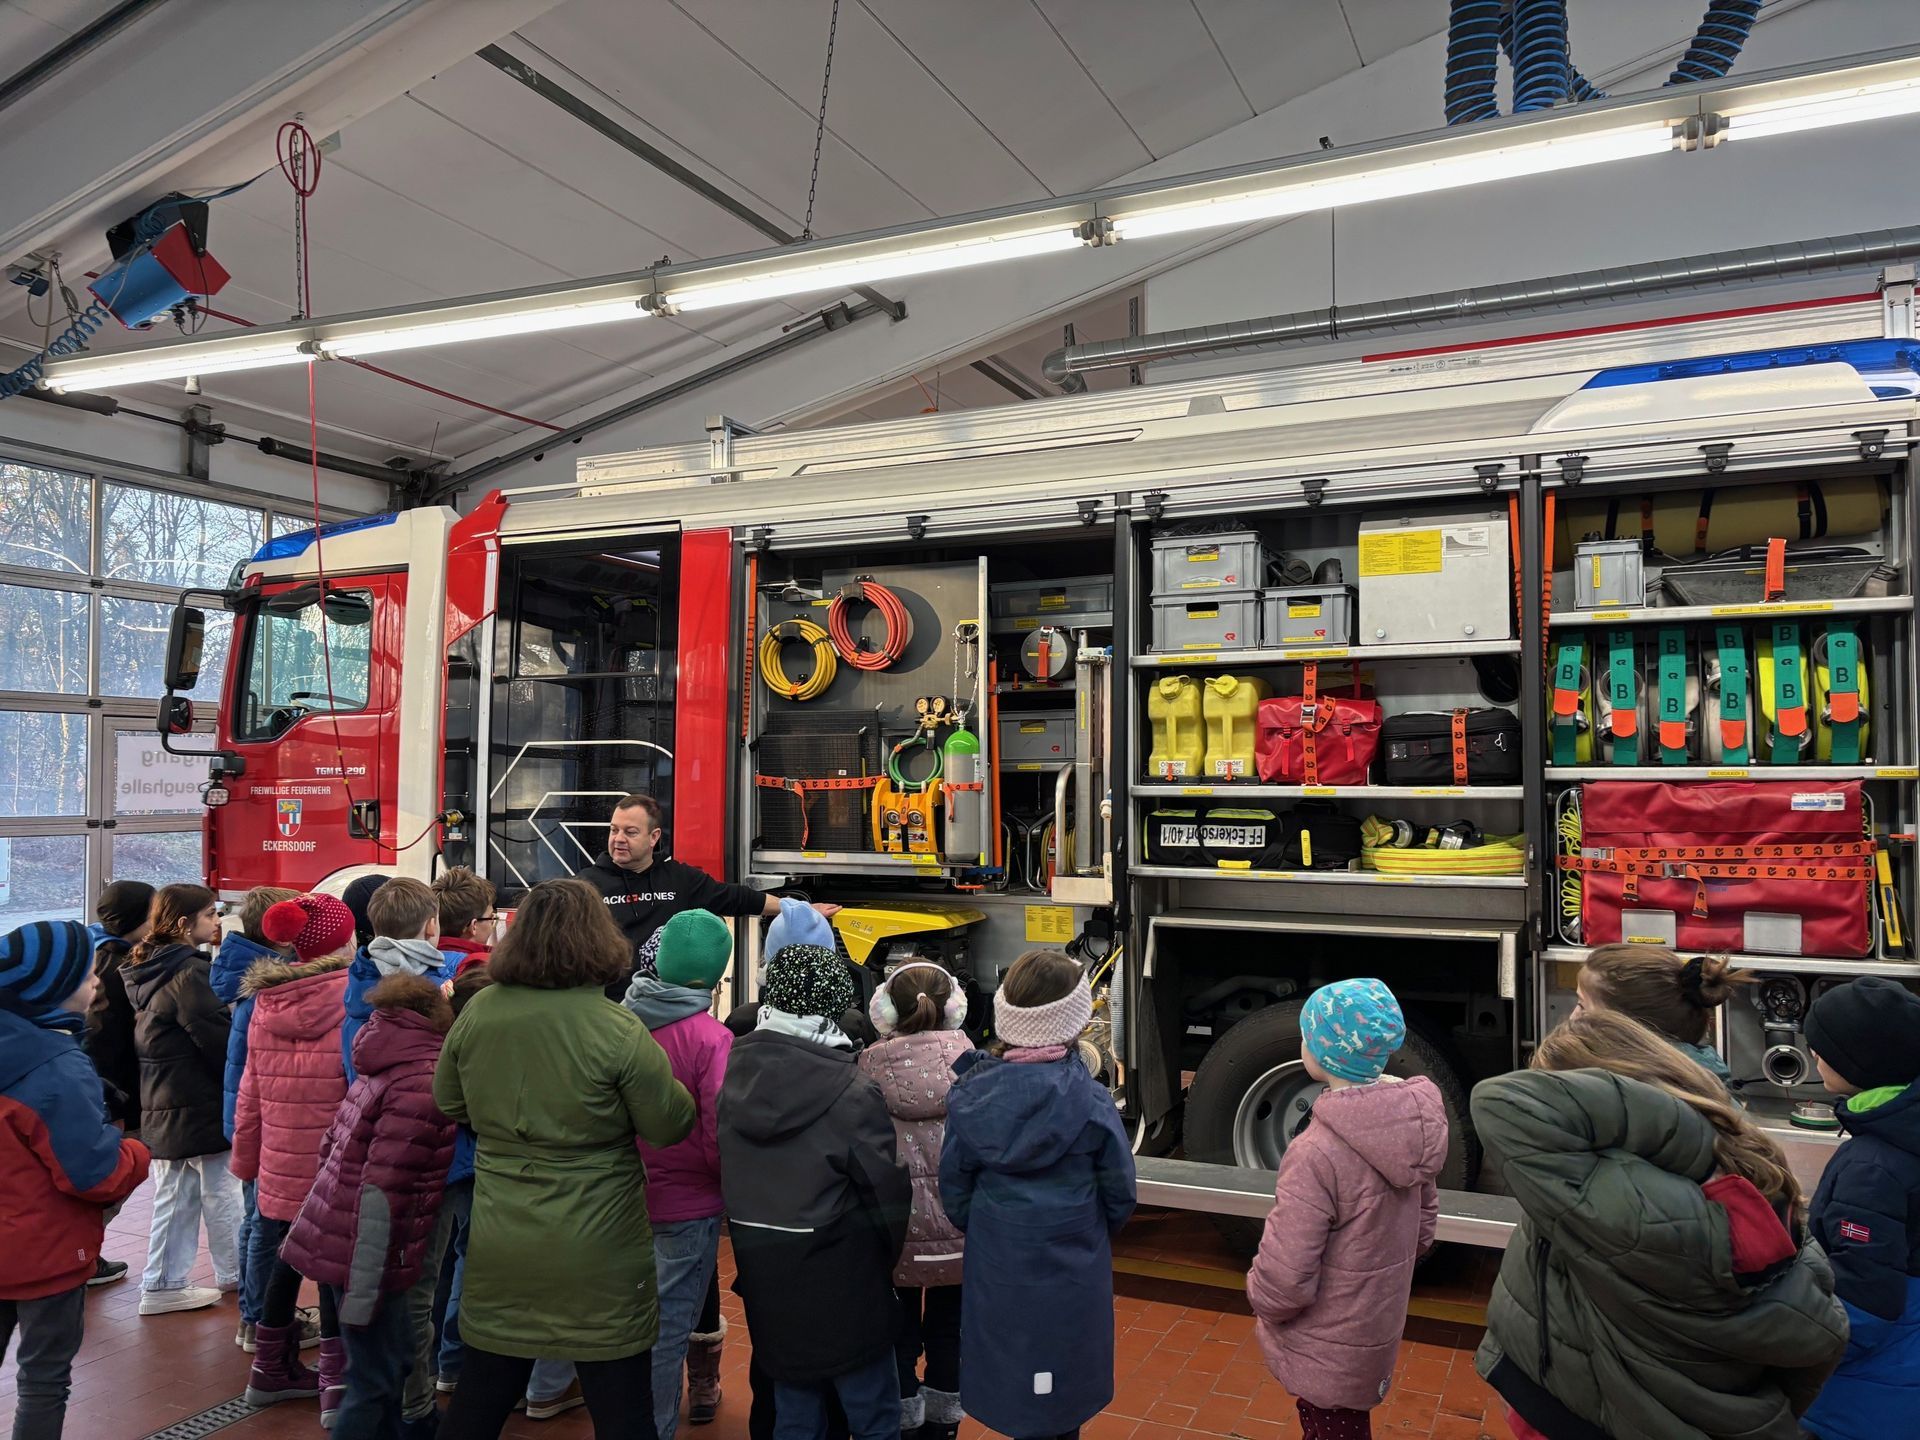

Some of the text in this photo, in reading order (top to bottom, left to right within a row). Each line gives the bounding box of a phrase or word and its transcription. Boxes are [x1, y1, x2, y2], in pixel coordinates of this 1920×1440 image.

[1562, 664, 1573, 680] B
[1836, 667, 1849, 683] B
[1617, 683, 1629, 699] B
[1782, 684, 1796, 699] B
[1666, 698, 1679, 713] B
[1726, 693, 1739, 709] B
[315, 767, 333, 775] TGM
[250, 786, 331, 795] FREIWILLIGE FEUERWEHR
[1162, 826, 1184, 844] 40/1
[1250, 828, 1263, 845] FF
[262, 840, 317, 852] ECKERSDORF
